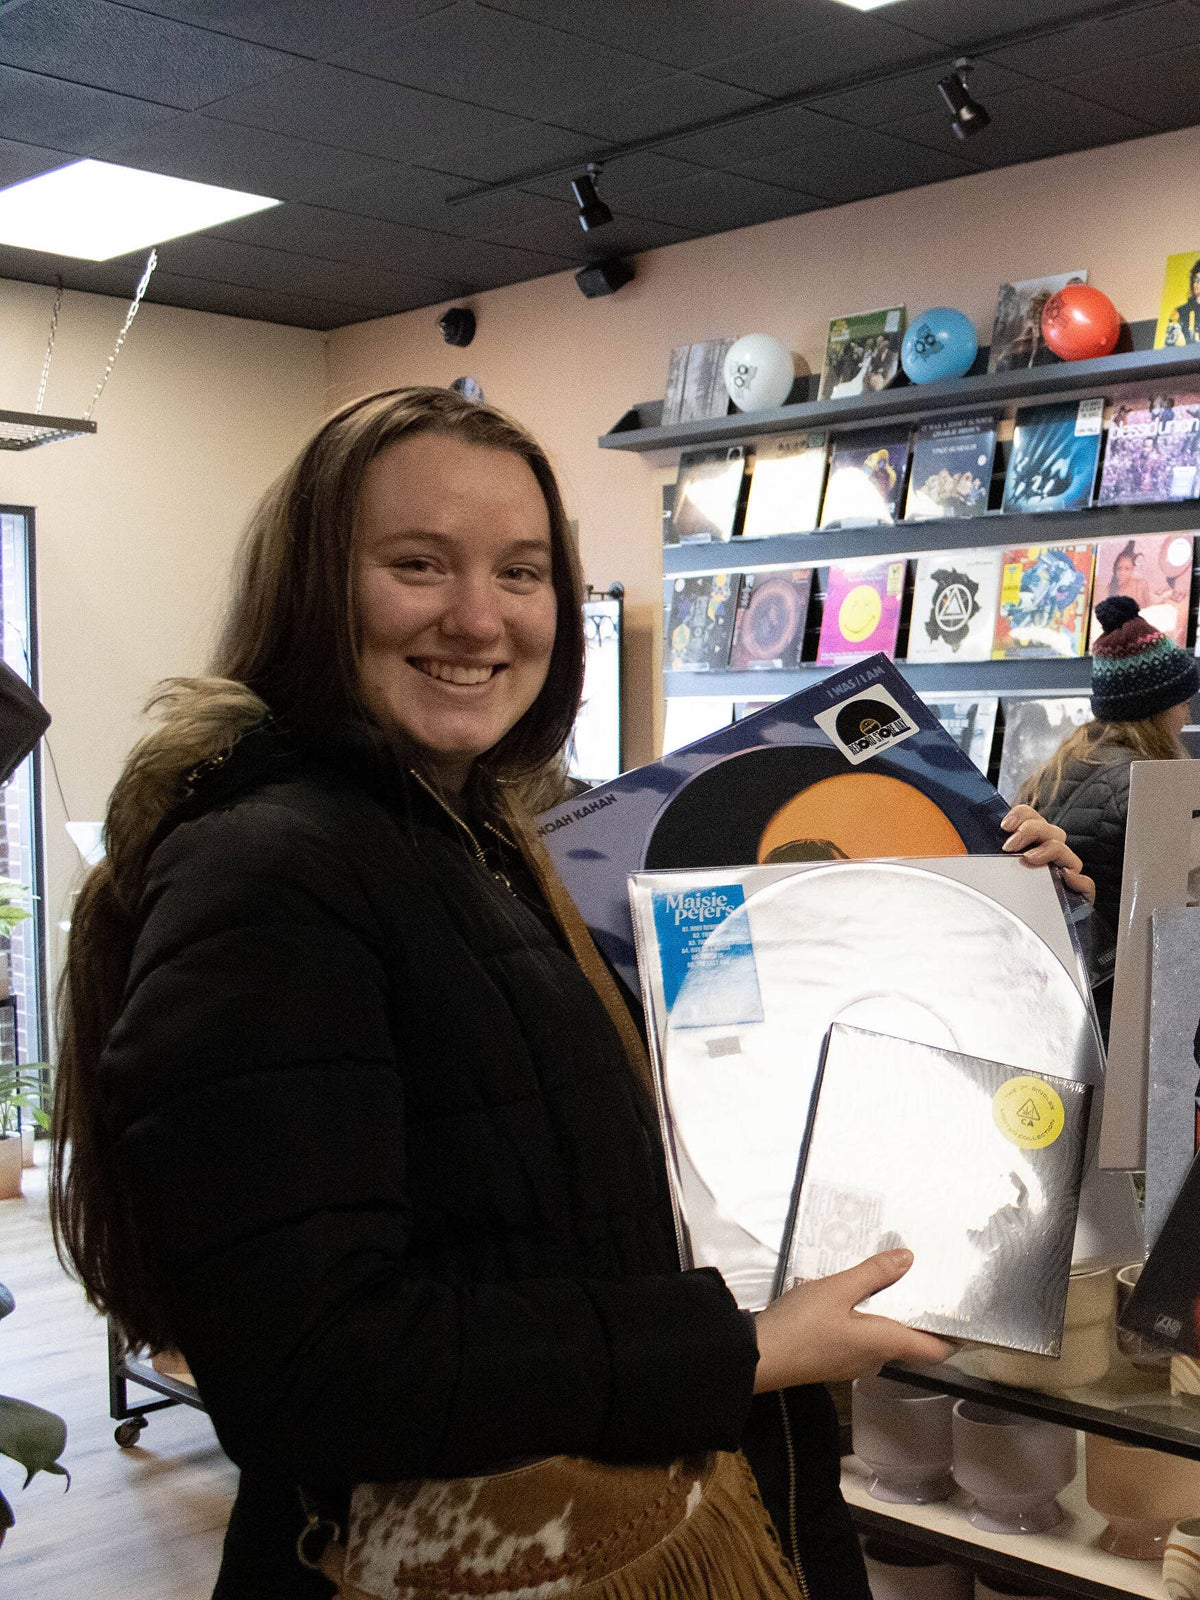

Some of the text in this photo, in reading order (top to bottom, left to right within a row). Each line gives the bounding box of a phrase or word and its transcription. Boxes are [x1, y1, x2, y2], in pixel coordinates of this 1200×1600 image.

[832, 679, 856, 696] WAS
[866, 666, 886, 681] AM
[847, 736, 877, 756] RECORD
[537, 793, 618, 838] NOAH KAHAN
[665, 892, 729, 913] Maisie
[1018, 1118, 1056, 1141] COLLECTION
[1020, 1118, 1035, 1128] CA
